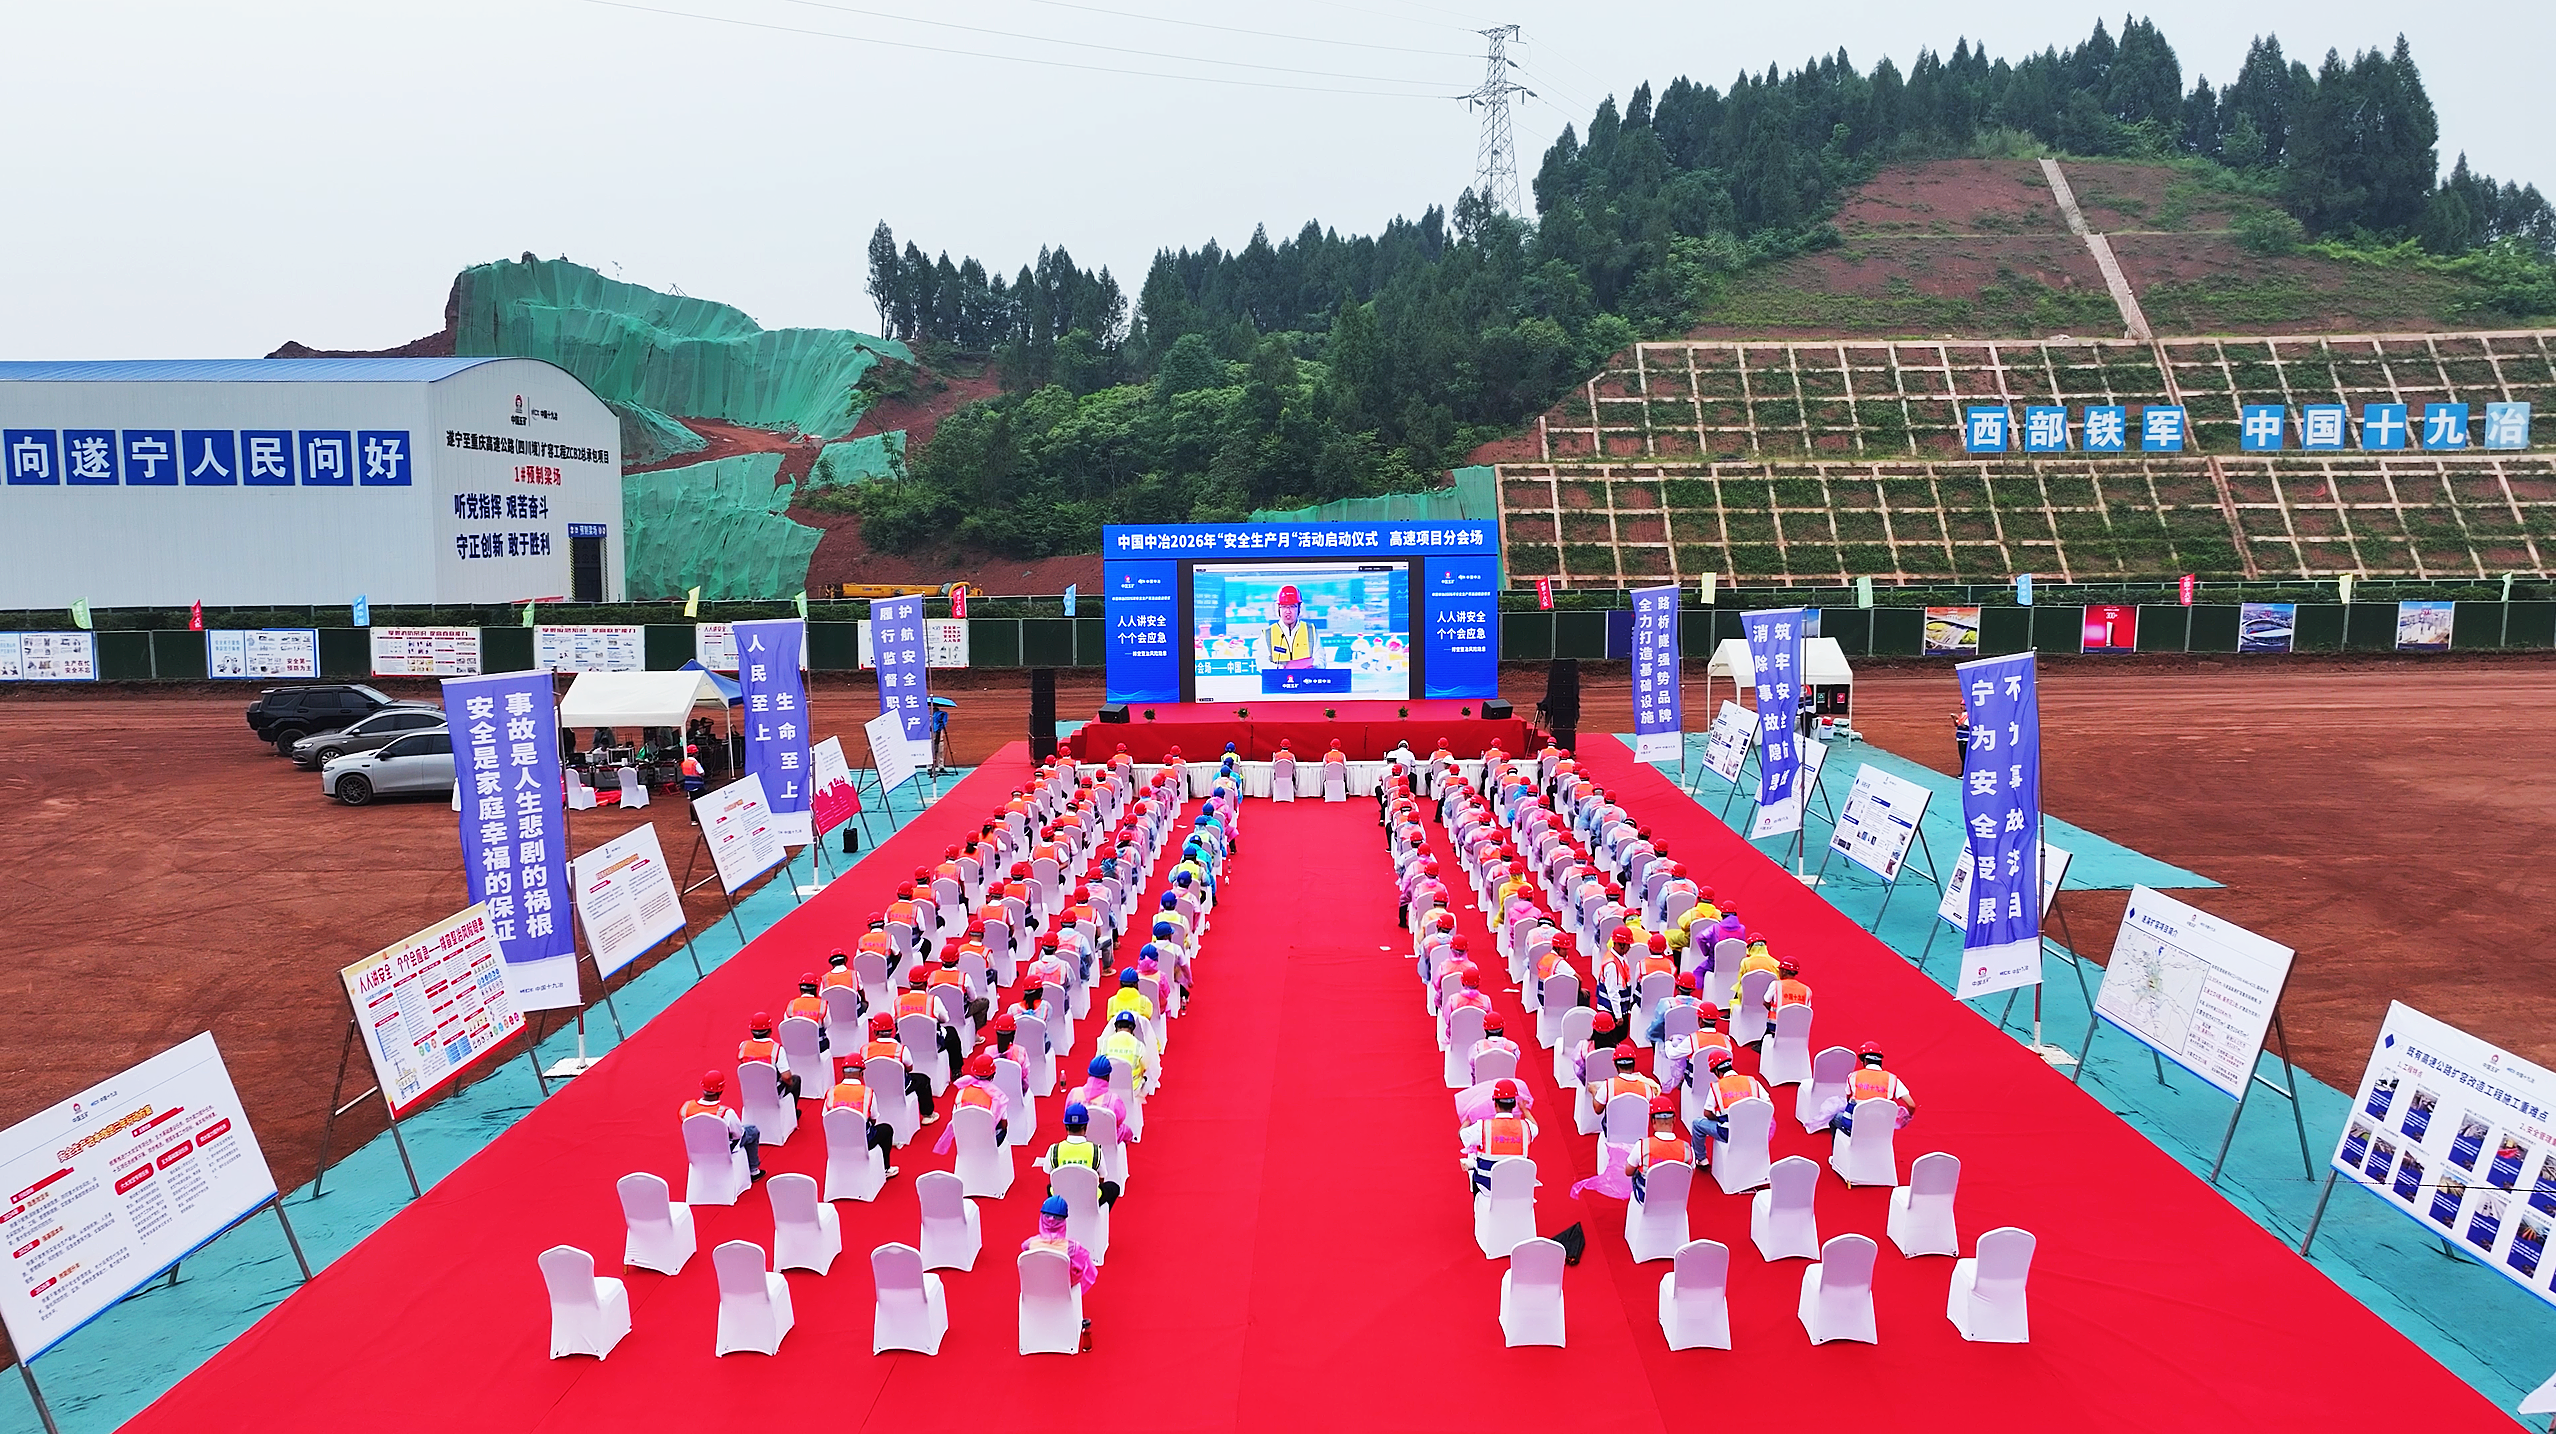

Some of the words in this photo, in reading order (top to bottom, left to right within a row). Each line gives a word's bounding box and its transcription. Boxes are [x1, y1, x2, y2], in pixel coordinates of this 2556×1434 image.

[1971, 411, 2182, 448] 西部铁军
[2244, 408, 2527, 447] 中国十九冶
[12, 436, 404, 479] 向遂宁人民问好
[514, 465, 562, 487] 1#预制梁场
[454, 493, 502, 520] 听党指挥
[506, 494, 549, 520] 艰苦奋斗
[456, 532, 503, 560] 守正创新
[508, 532, 551, 557] 敢于胜利
[1390, 529, 1484, 548] 高速项目分会场
[1117, 615, 1167, 628] 人人讲安全
[1117, 632, 1167, 644] 个个会应急
[1436, 610, 1486, 623] 人人讲安全
[1436, 628, 1486, 640] 个个会应急
[879, 606, 901, 711] 履行监督职
[898, 604, 922, 731] 护航安全生产
[1194, 660, 1258, 675] 会场——中国二十
[1638, 598, 1656, 725] 全力打造基础设施
[1656, 596, 1673, 724] 路桥隧强势品牌
[748, 634, 772, 742] 人民至上
[776, 692, 799, 799] 生命至上
[466, 696, 517, 942] 安全是家庭幸福的保证
[504, 691, 554, 939] 事故是人生悲剧的祸根
[1970, 679, 1998, 925] 宁为安全受累
[2406, 1045, 2549, 1123] 既有高速公路扩容改造工程施工重难点
